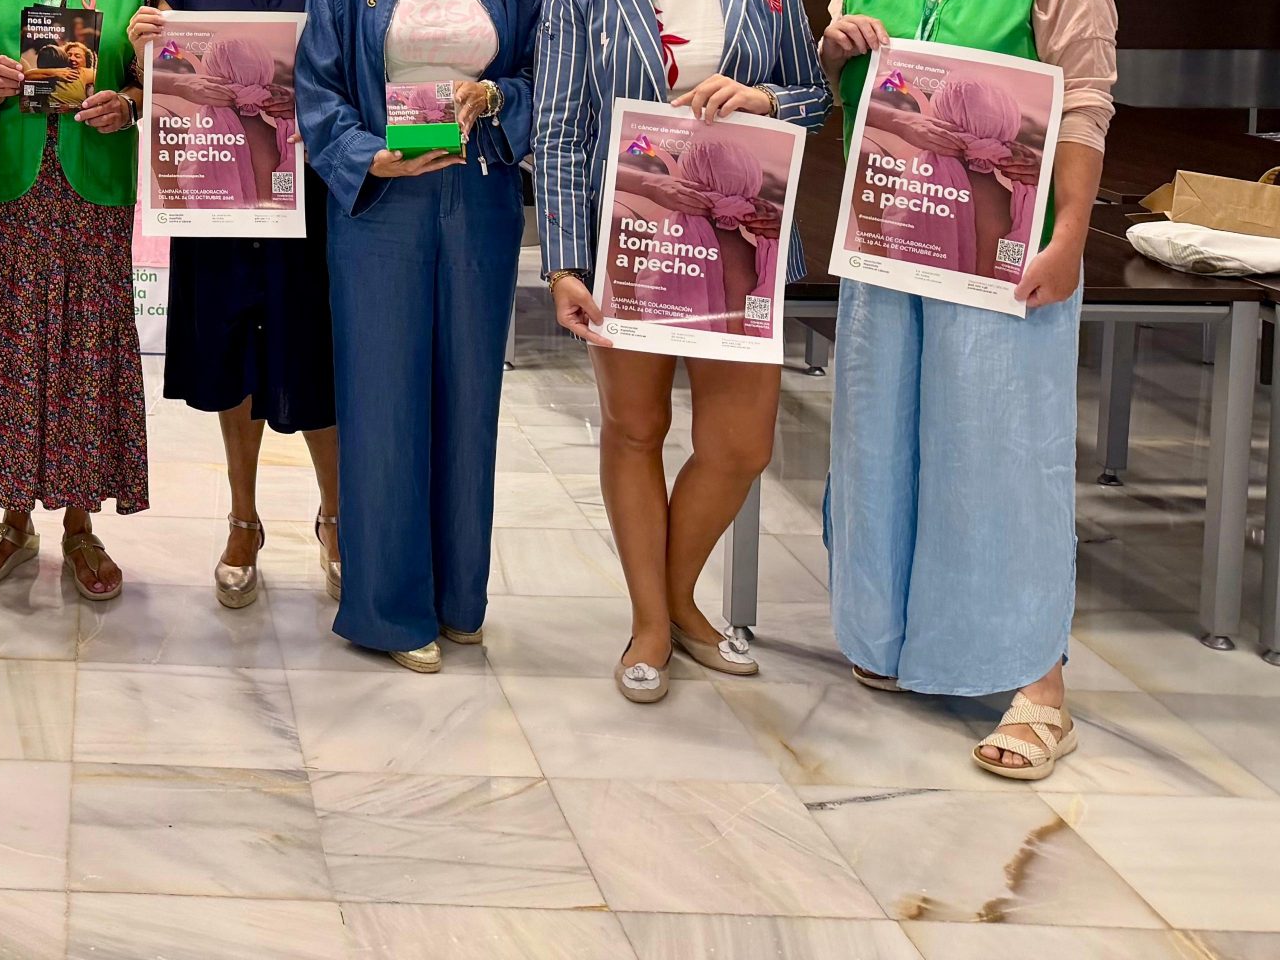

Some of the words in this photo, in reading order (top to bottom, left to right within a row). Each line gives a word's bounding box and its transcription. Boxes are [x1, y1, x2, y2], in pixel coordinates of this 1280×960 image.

[159, 116, 191, 128] nos
[195, 112, 213, 128] lo
[158, 130, 244, 145] tomamos
[158, 150, 169, 161] a
[174, 146, 235, 165] pecho.
[867, 153, 906, 171] nos
[911, 156, 933, 176] lo
[865, 167, 970, 202] tomamos
[861, 189, 874, 202] a
[879, 192, 954, 218] pecho.
[620, 217, 658, 234] nos
[662, 218, 683, 237] lo
[618, 232, 718, 260] tomamos
[615, 254, 628, 267] a
[633, 254, 704, 277] pecho.
